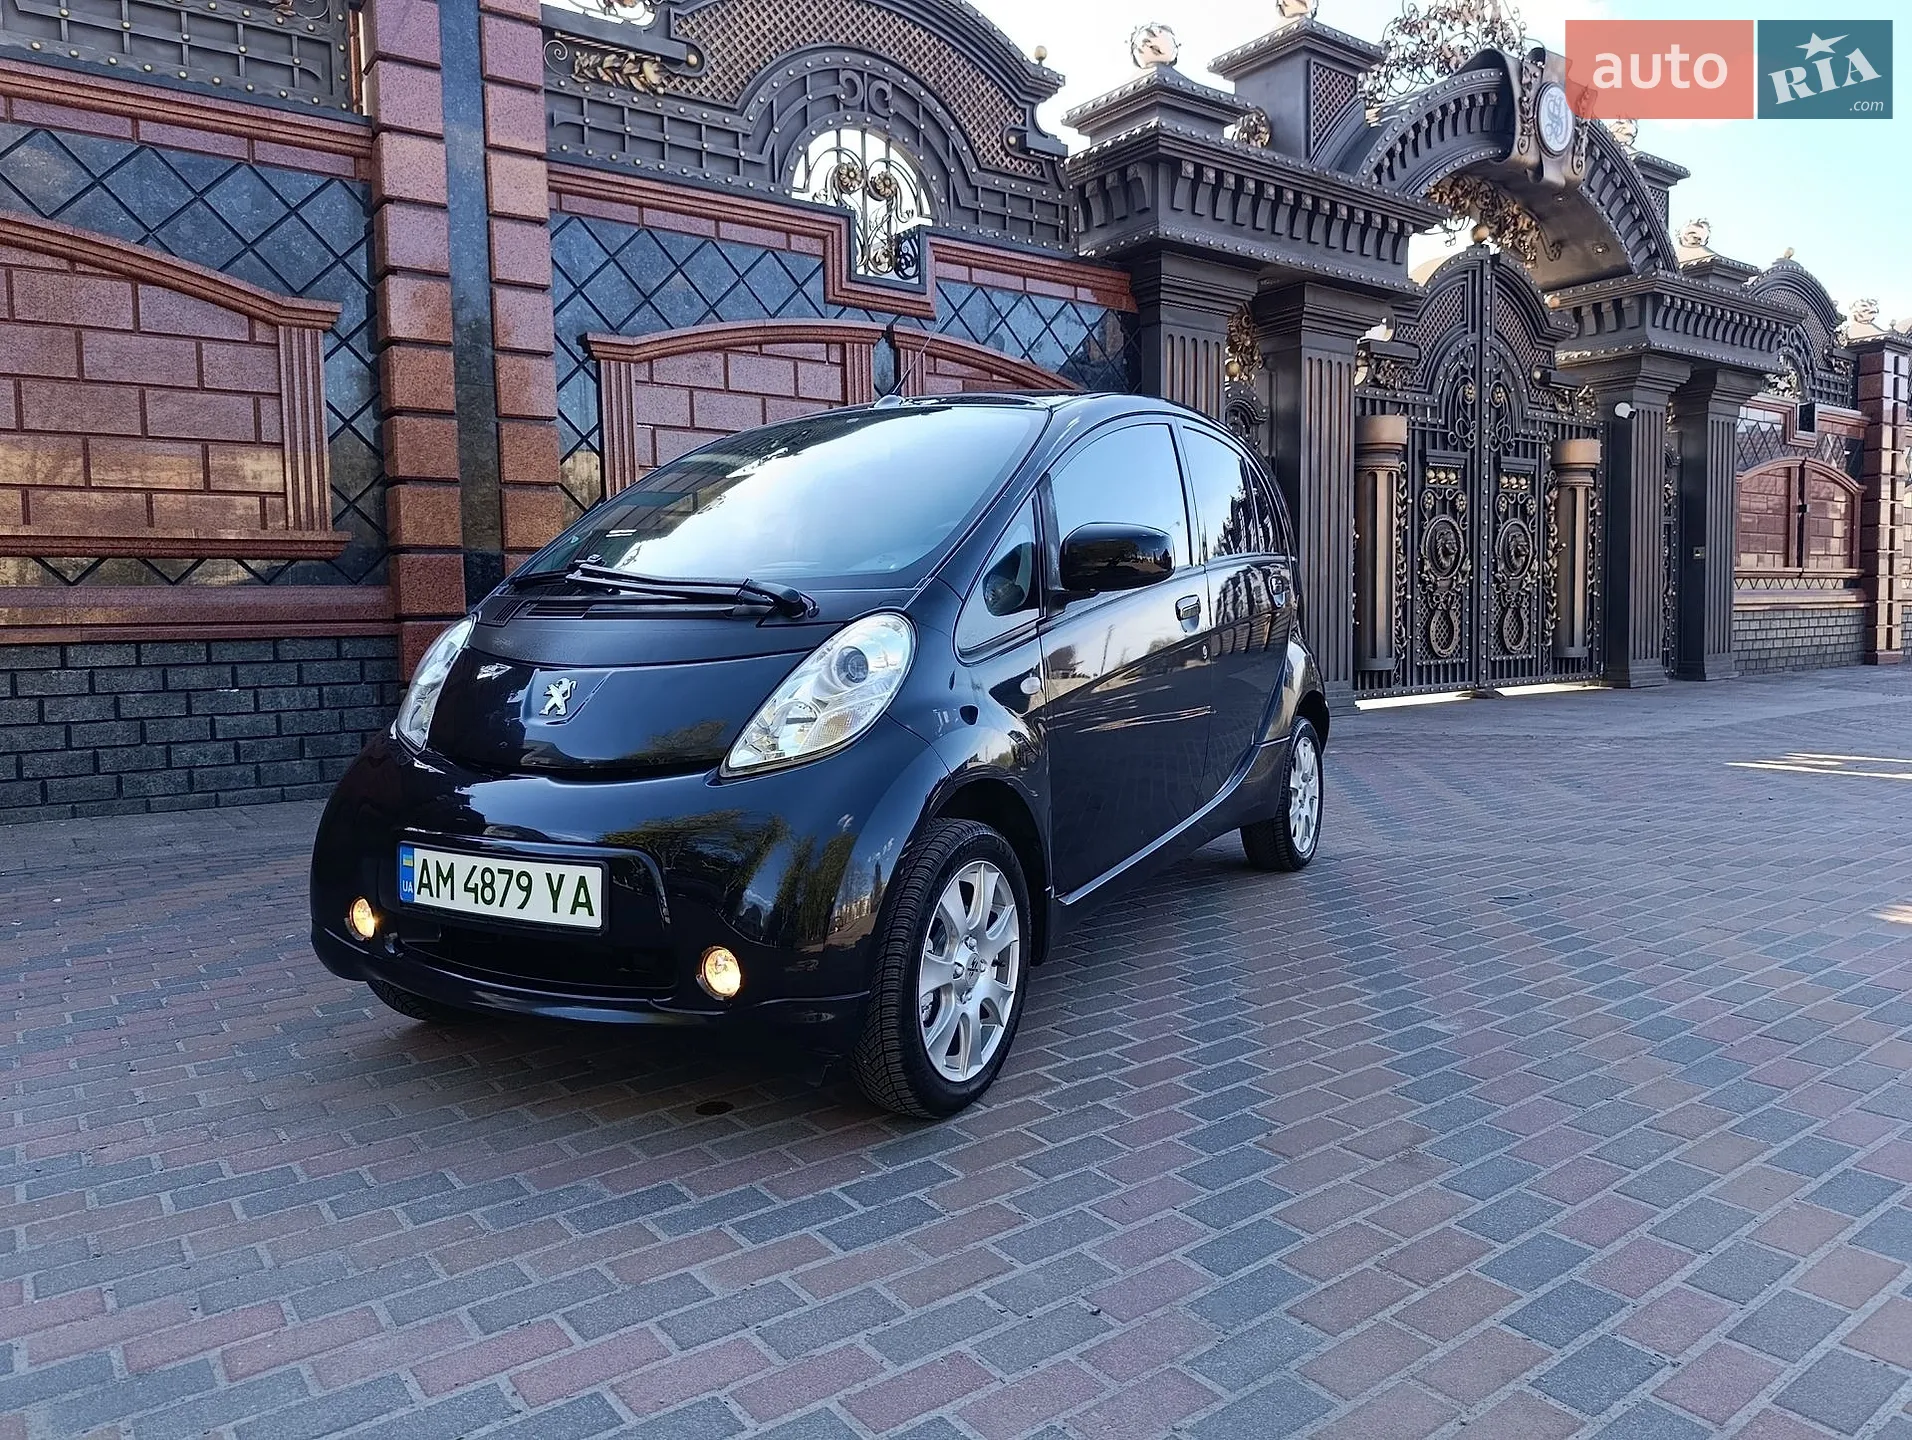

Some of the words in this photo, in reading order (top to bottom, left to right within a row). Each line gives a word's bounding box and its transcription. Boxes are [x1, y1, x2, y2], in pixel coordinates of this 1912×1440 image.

[402, 881, 413, 894] UA
[417, 858, 455, 900] AM
[463, 865, 533, 909] 4879
[546, 872, 595, 916] YA
